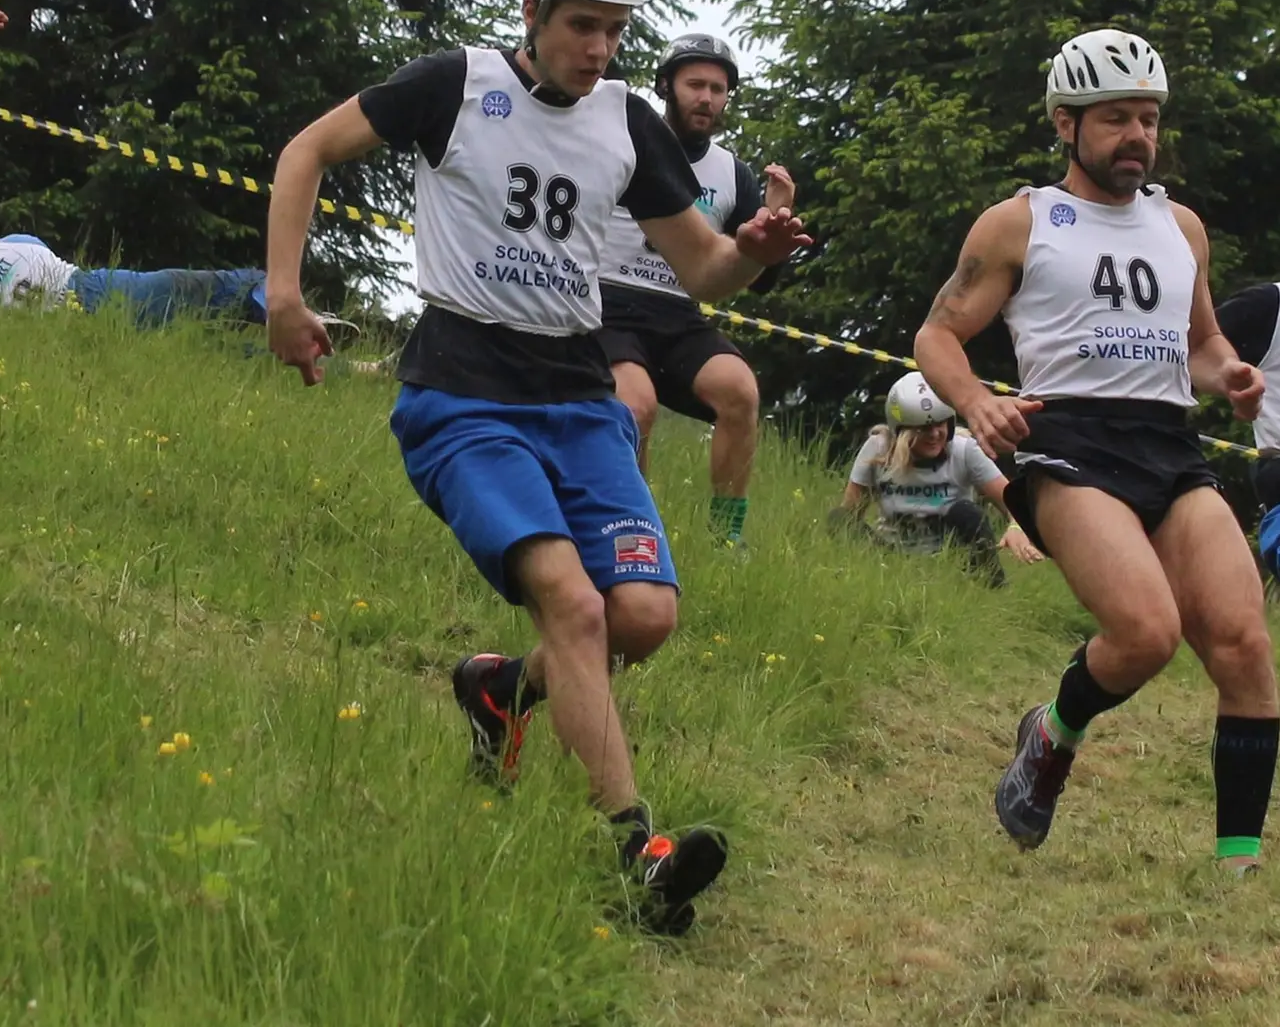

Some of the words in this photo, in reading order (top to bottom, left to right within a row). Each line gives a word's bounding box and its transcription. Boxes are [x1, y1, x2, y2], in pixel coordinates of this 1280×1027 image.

[502, 162, 580, 243] 38
[495, 245, 558, 270] SCUOLA
[474, 261, 590, 298] S.VALENTINO
[620, 265, 683, 287] S.VALEN
[1090, 253, 1161, 314] 40
[1094, 326, 1156, 340] SCUOLA
[1159, 330, 1180, 343] SCI
[601, 518, 635, 535] GRAND
